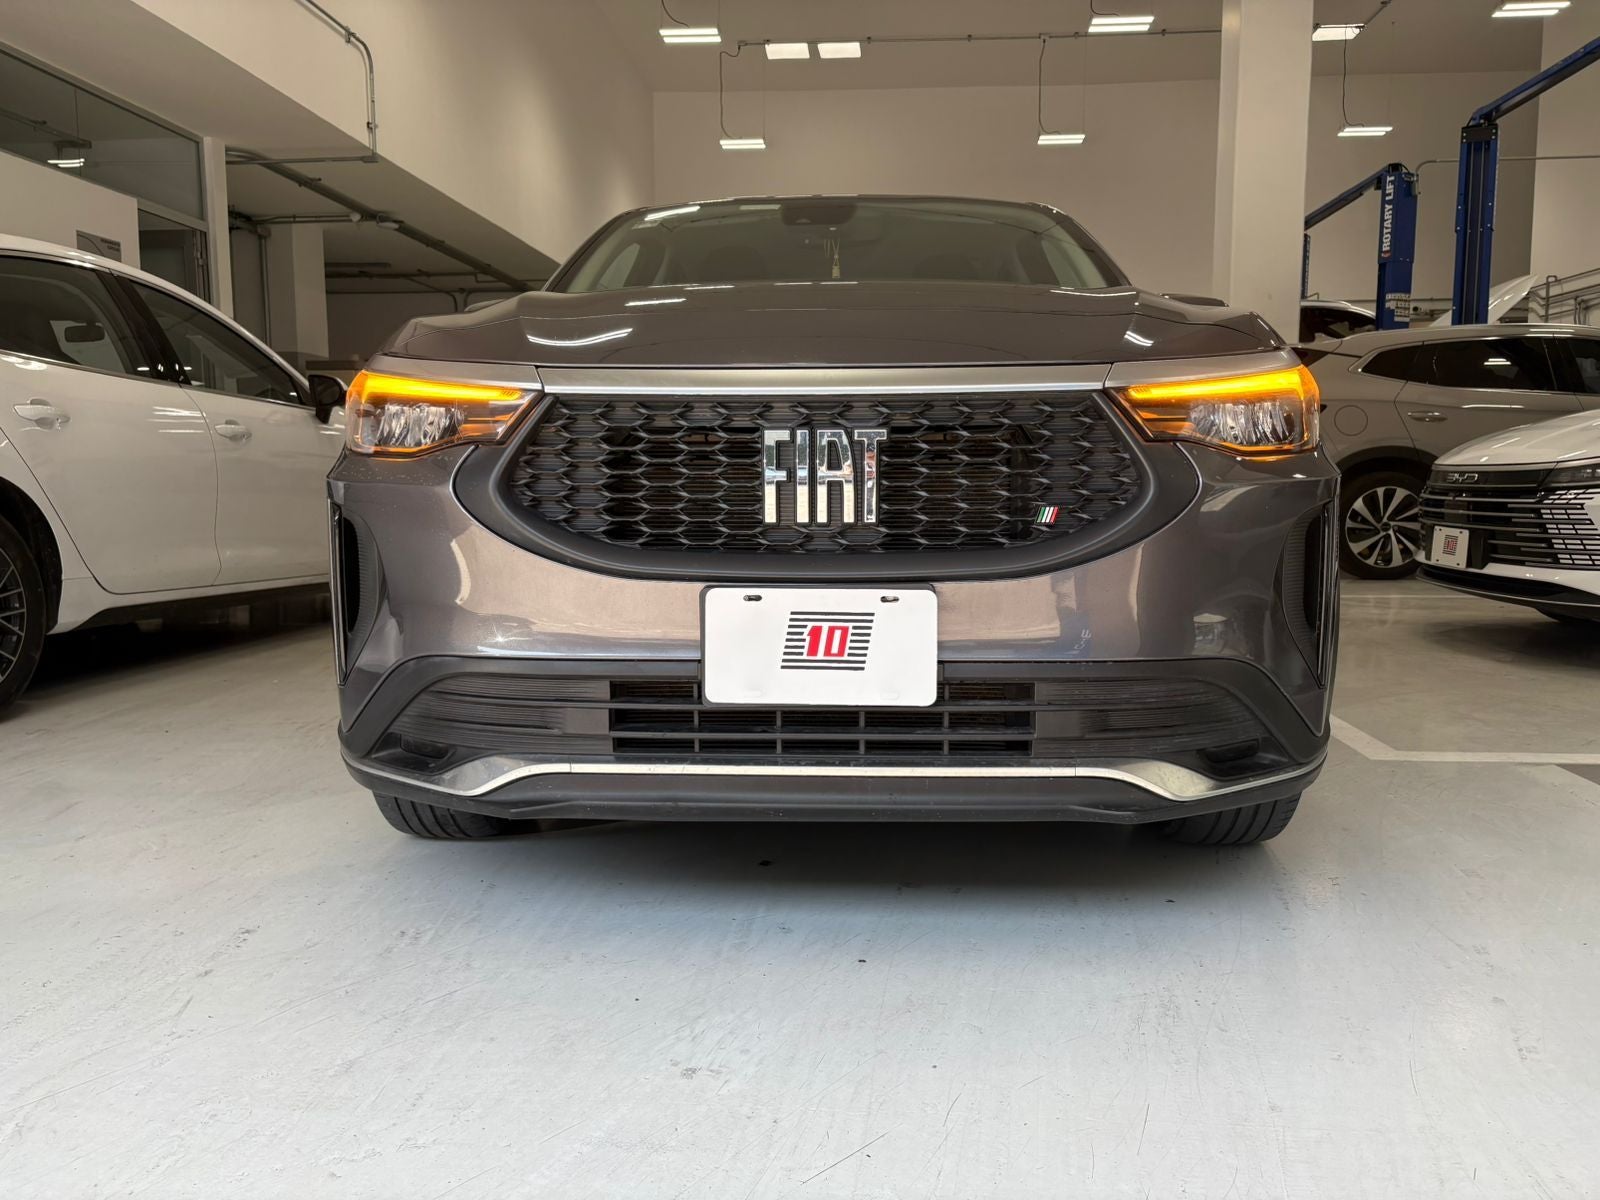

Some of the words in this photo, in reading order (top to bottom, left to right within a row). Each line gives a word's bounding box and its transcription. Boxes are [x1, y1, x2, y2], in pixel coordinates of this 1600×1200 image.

[1385, 175, 1395, 200] LIFT
[1382, 204, 1393, 251] ROTARY
[763, 429, 888, 523] FIAT
[806, 625, 850, 657] 10
